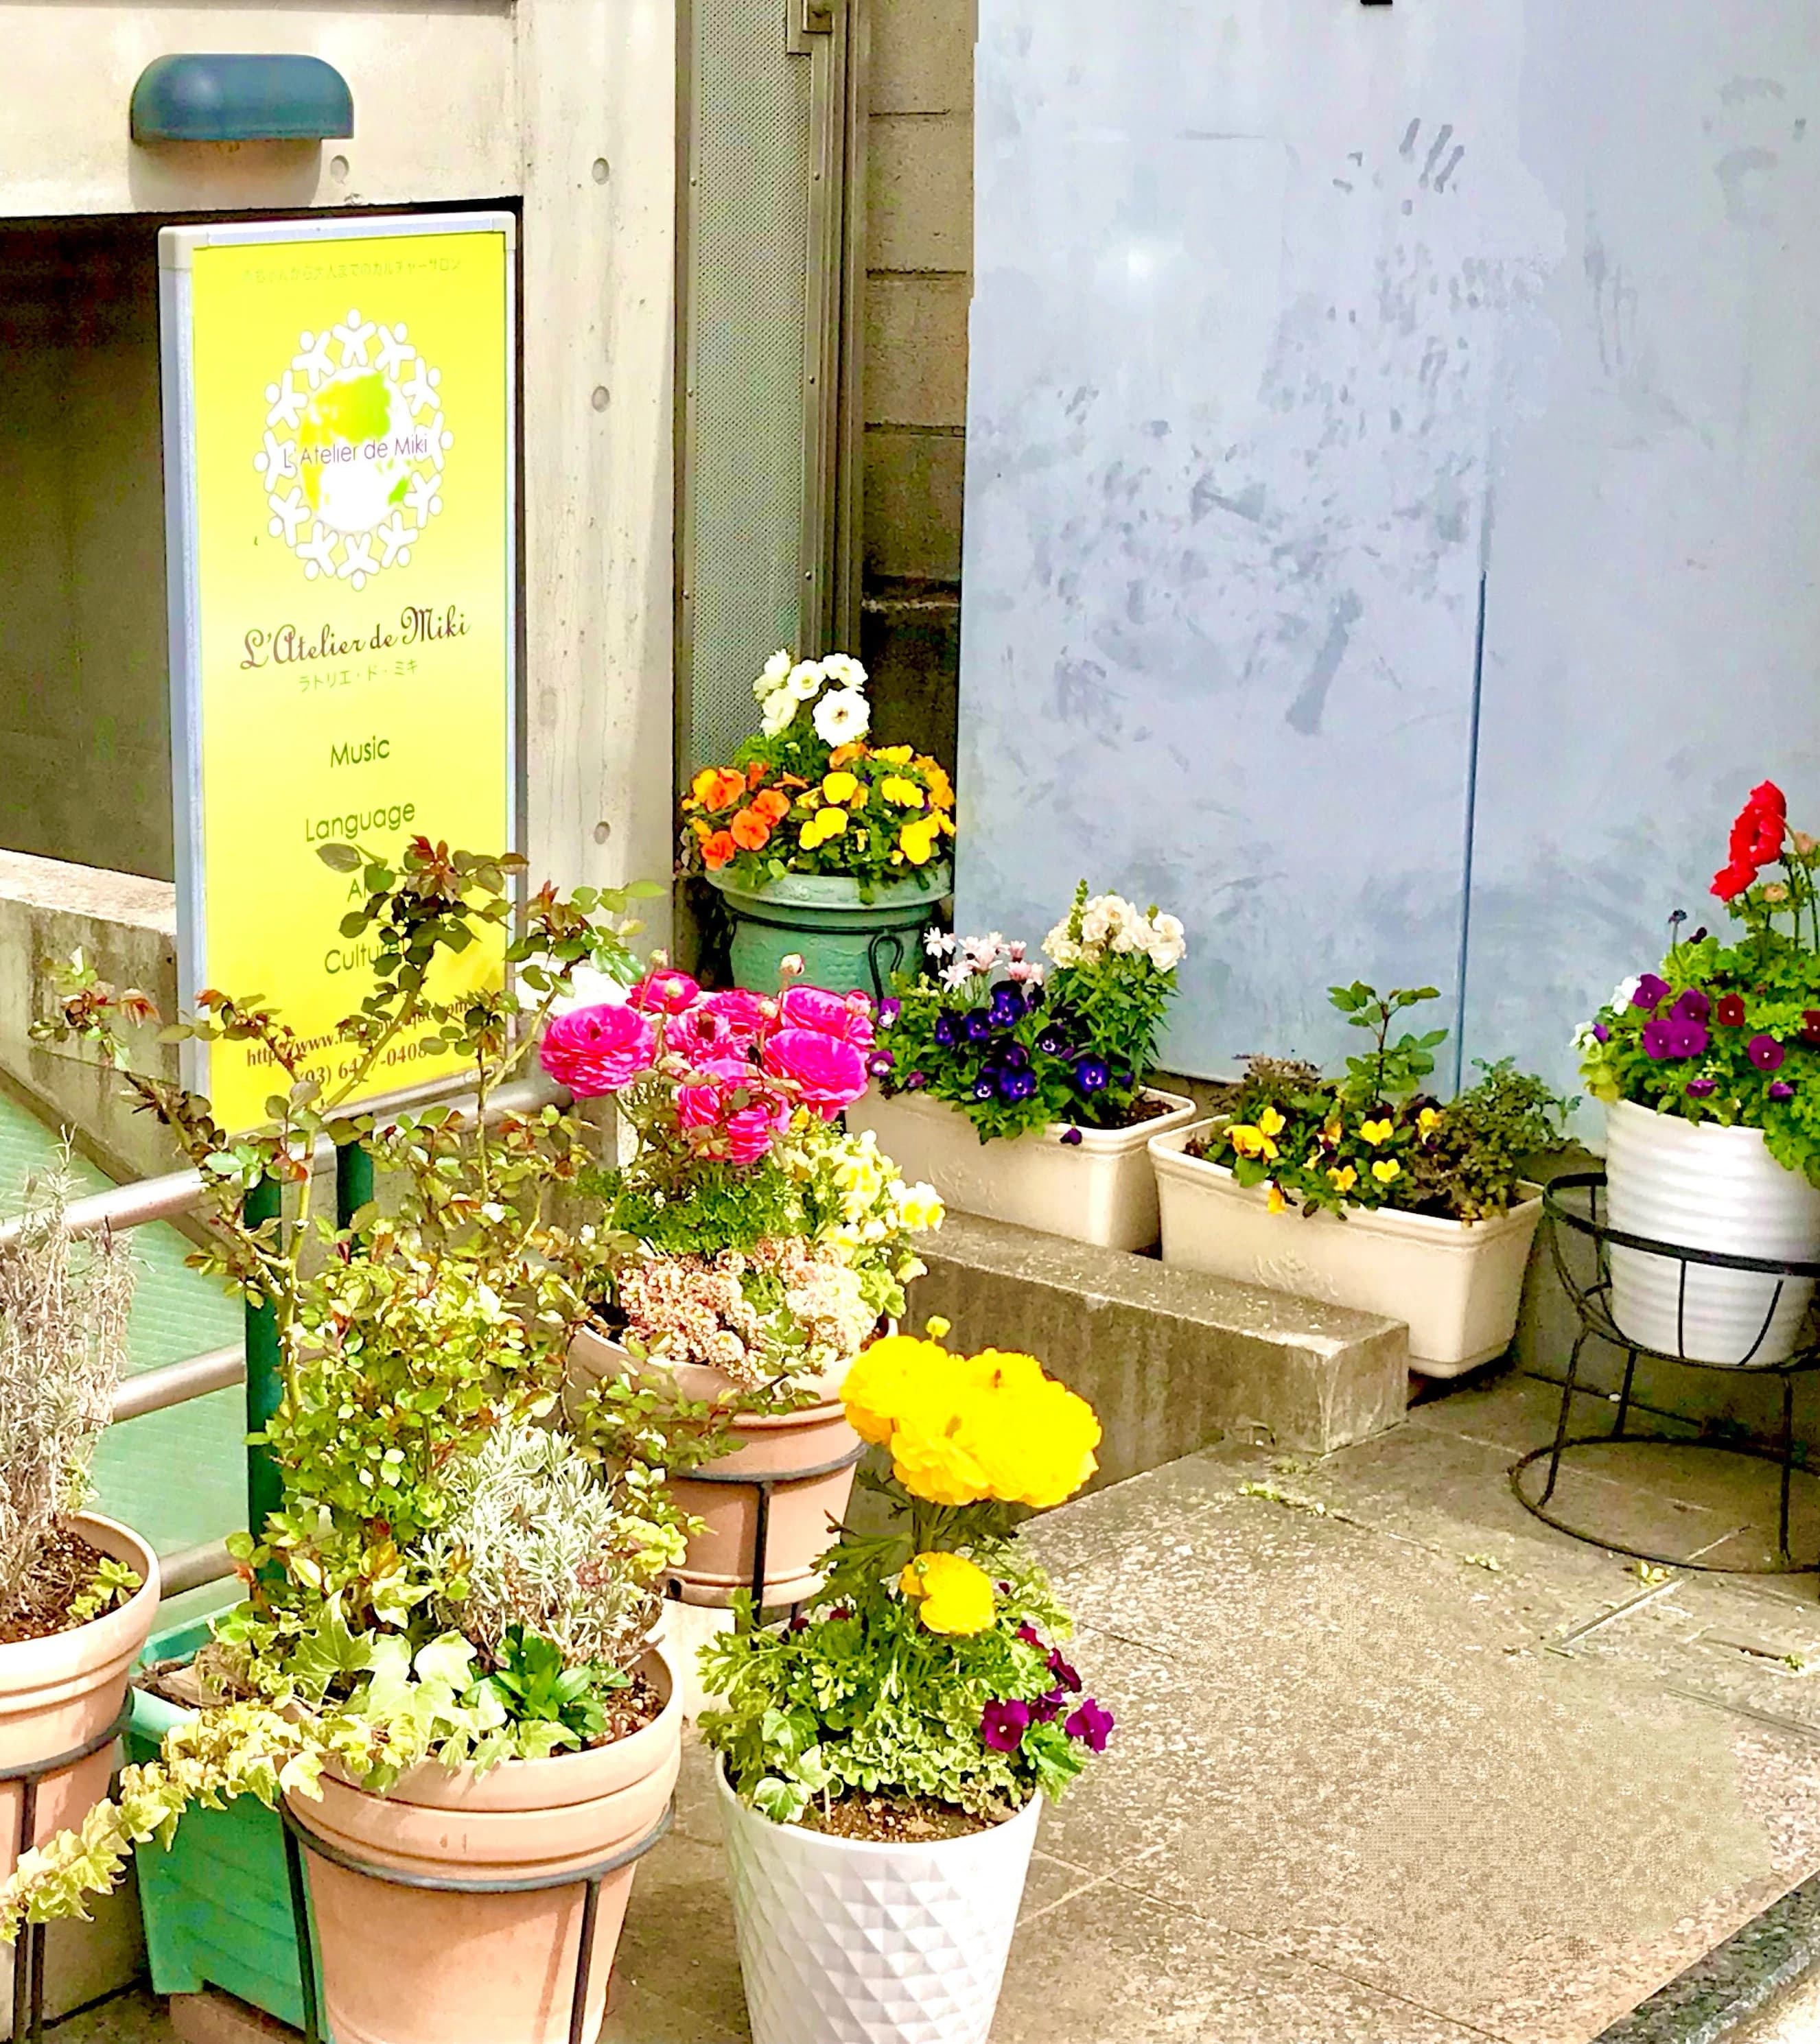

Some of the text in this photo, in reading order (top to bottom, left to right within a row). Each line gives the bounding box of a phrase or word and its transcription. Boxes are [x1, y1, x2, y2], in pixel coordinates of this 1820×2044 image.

[364, 439, 388, 460] de
[394, 433, 428, 456] Miki
[240, 604, 471, 670] L'Atelier de Miki
[330, 735, 390, 768] Music
[306, 803, 415, 842] Language
